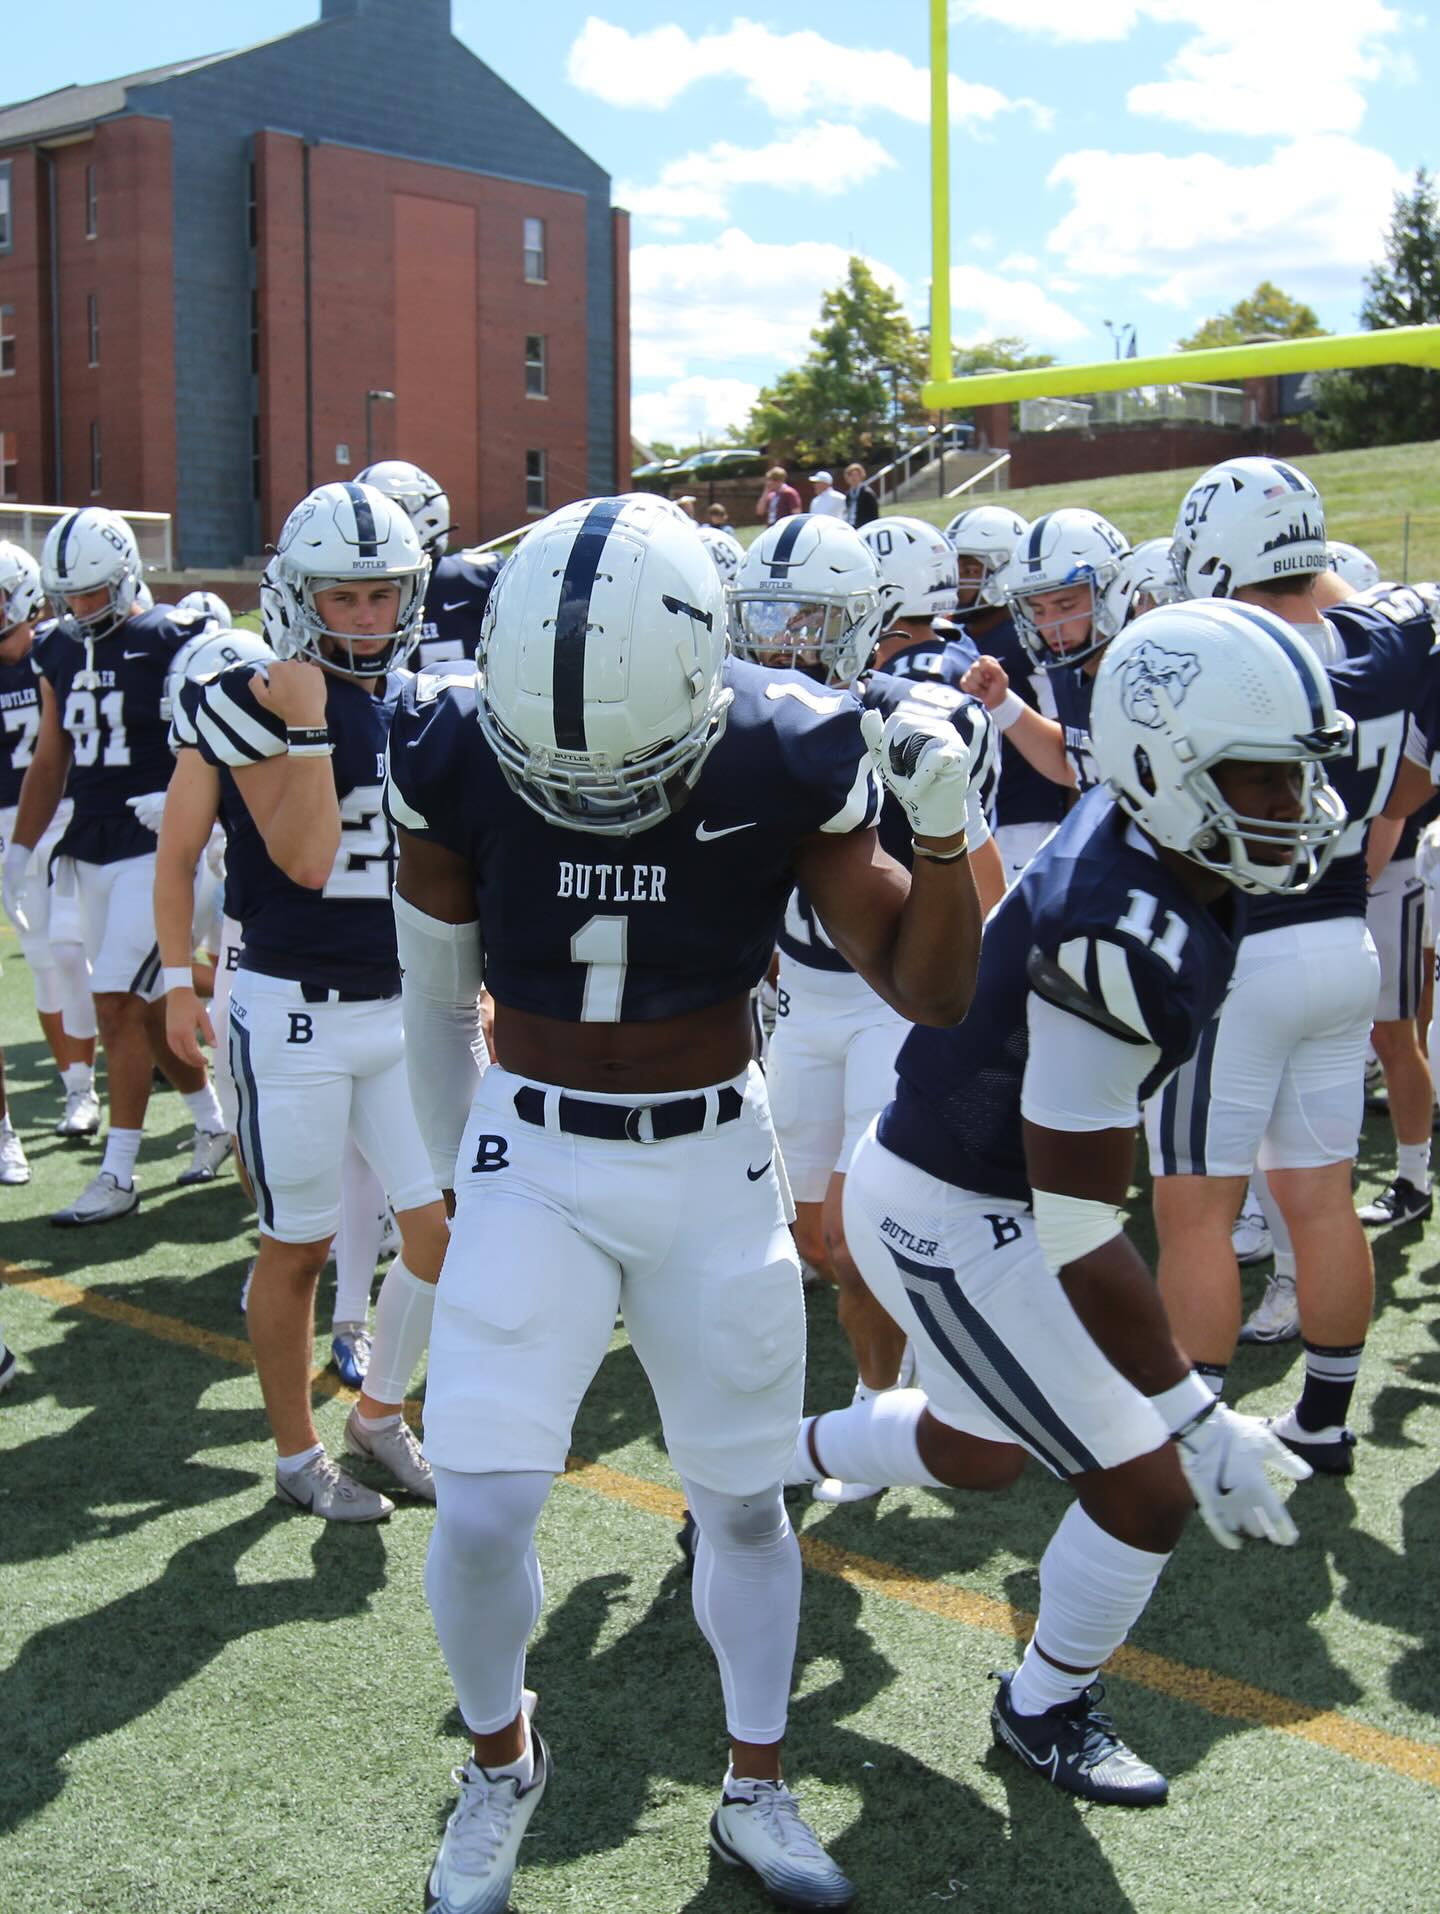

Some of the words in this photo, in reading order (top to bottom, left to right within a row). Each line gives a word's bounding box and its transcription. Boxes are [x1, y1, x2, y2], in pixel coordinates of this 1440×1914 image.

[1184, 482, 1220, 527] 57
[352, 560, 386, 569] BUTLER
[710, 541, 738, 571] 43
[759, 580, 792, 589] BUTLER
[662, 594, 713, 633] 1
[554, 752, 590, 761] BUTLER
[557, 861, 667, 902] BUTLER
[1114, 888, 1190, 974] 11
[570, 914, 628, 1023] 1
[286, 1012, 314, 1044] B
[471, 1134, 510, 1173] B
[879, 1216, 939, 1258] BUTLER
